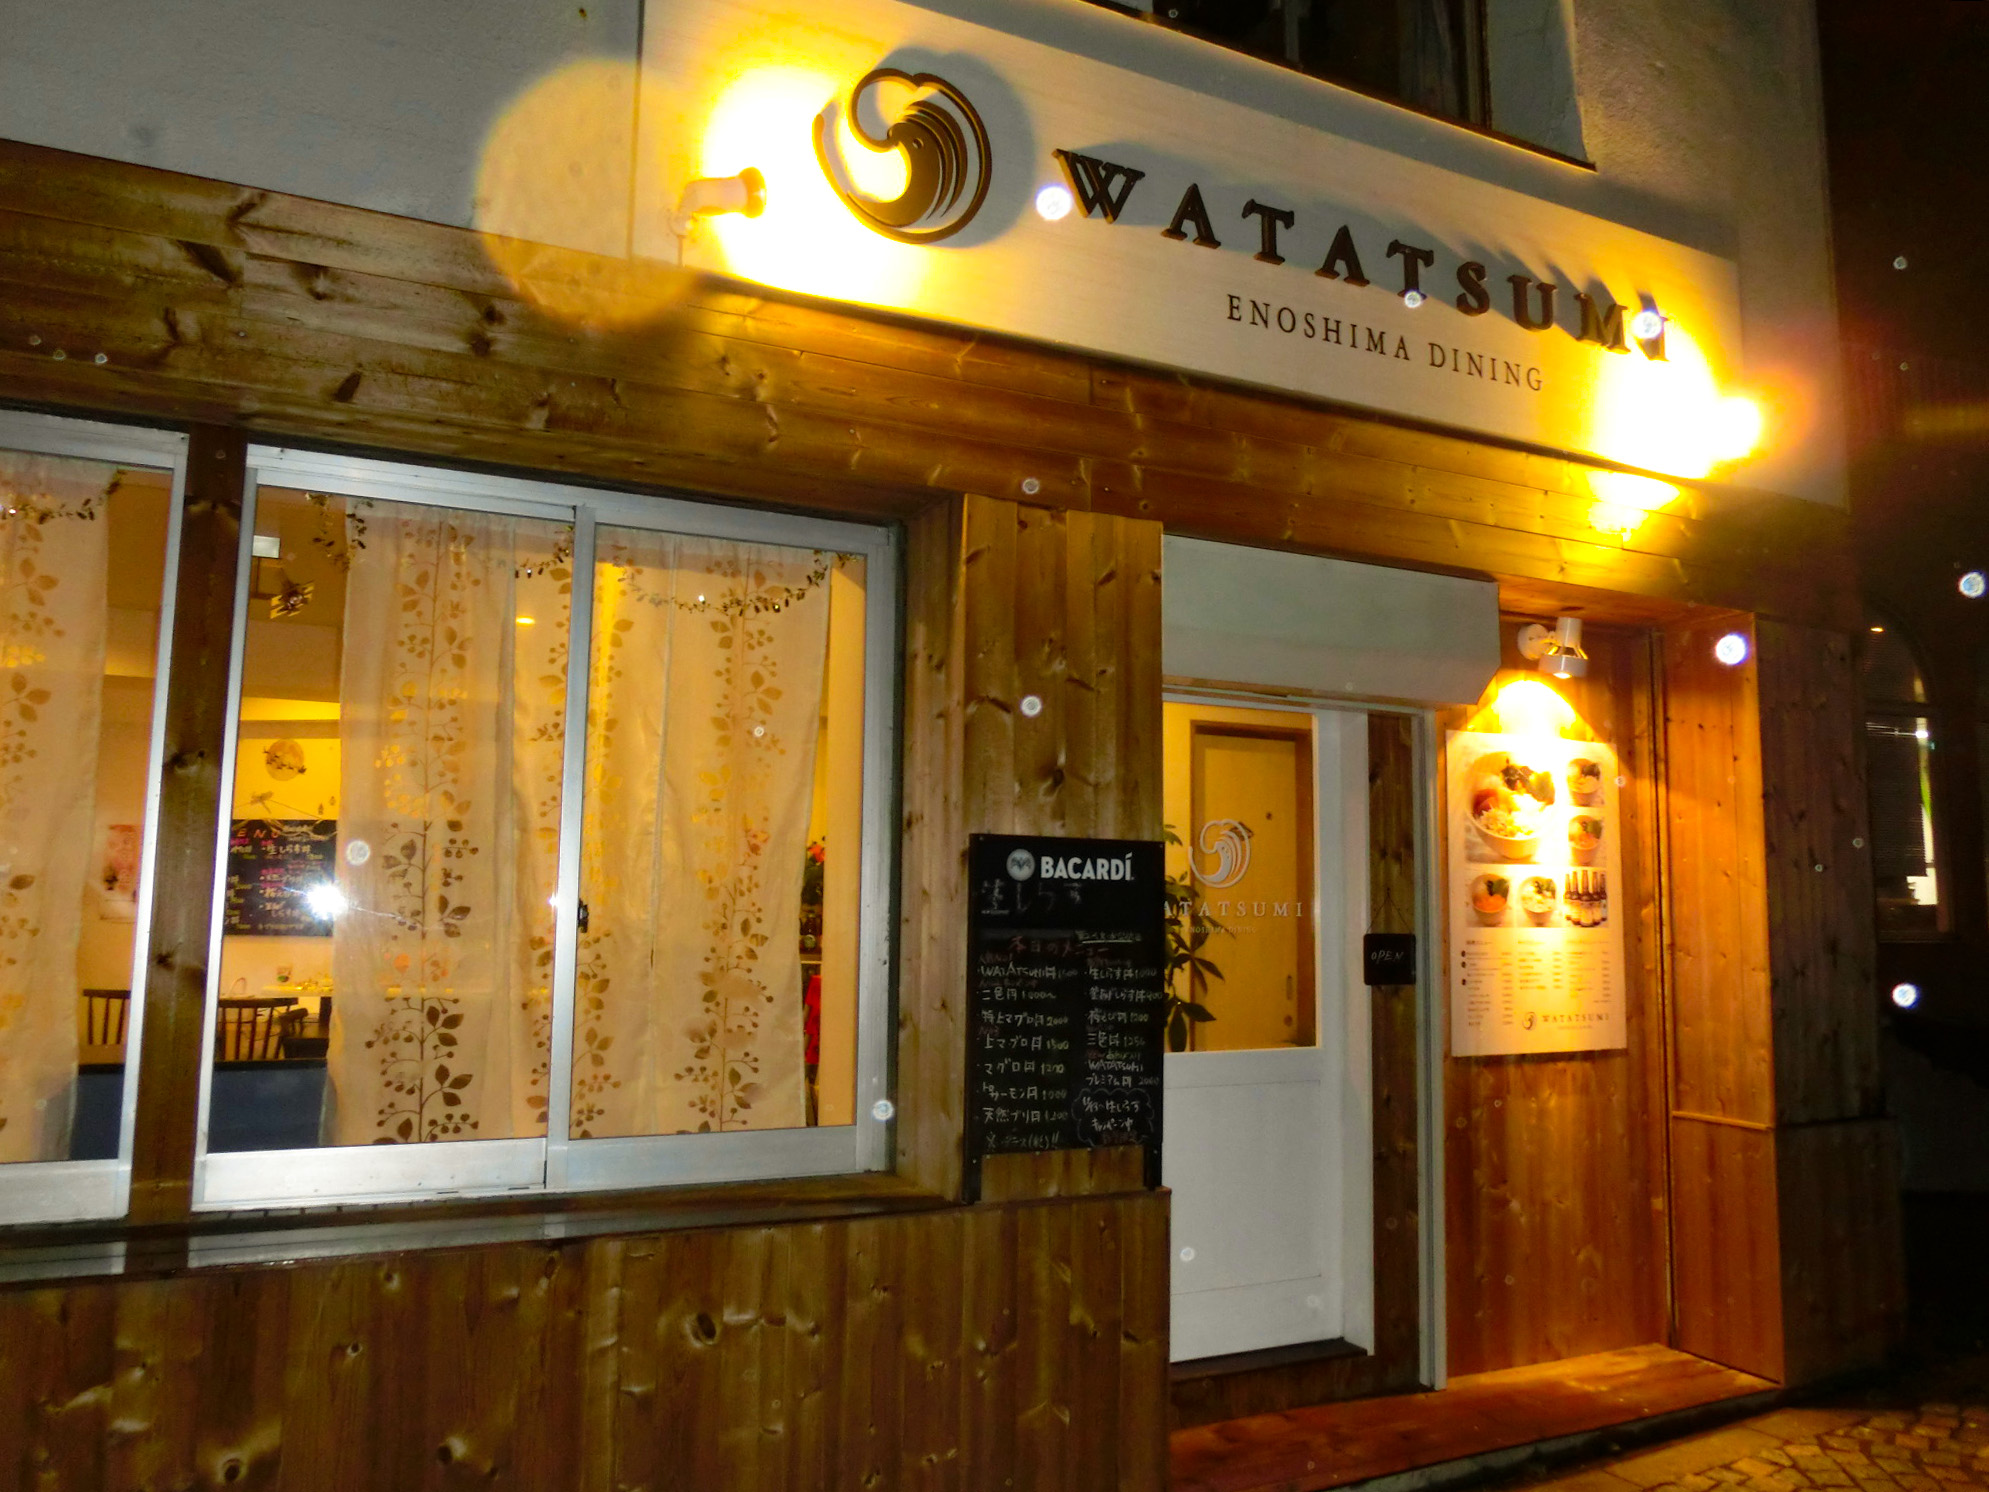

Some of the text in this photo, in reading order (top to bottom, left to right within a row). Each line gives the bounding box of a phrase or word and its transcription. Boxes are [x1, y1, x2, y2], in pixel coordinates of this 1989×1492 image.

[1053, 148, 1669, 362] WATATSUMI
[1226, 293, 1543, 392] ENOSHIMA DINING
[1040, 852, 1134, 881] BACARDÍ
[1163, 900, 1303, 917] ATATSUMI
[1371, 950, 1404, 965] OPEN
[984, 1057, 1035, 1075] マグロ丼
